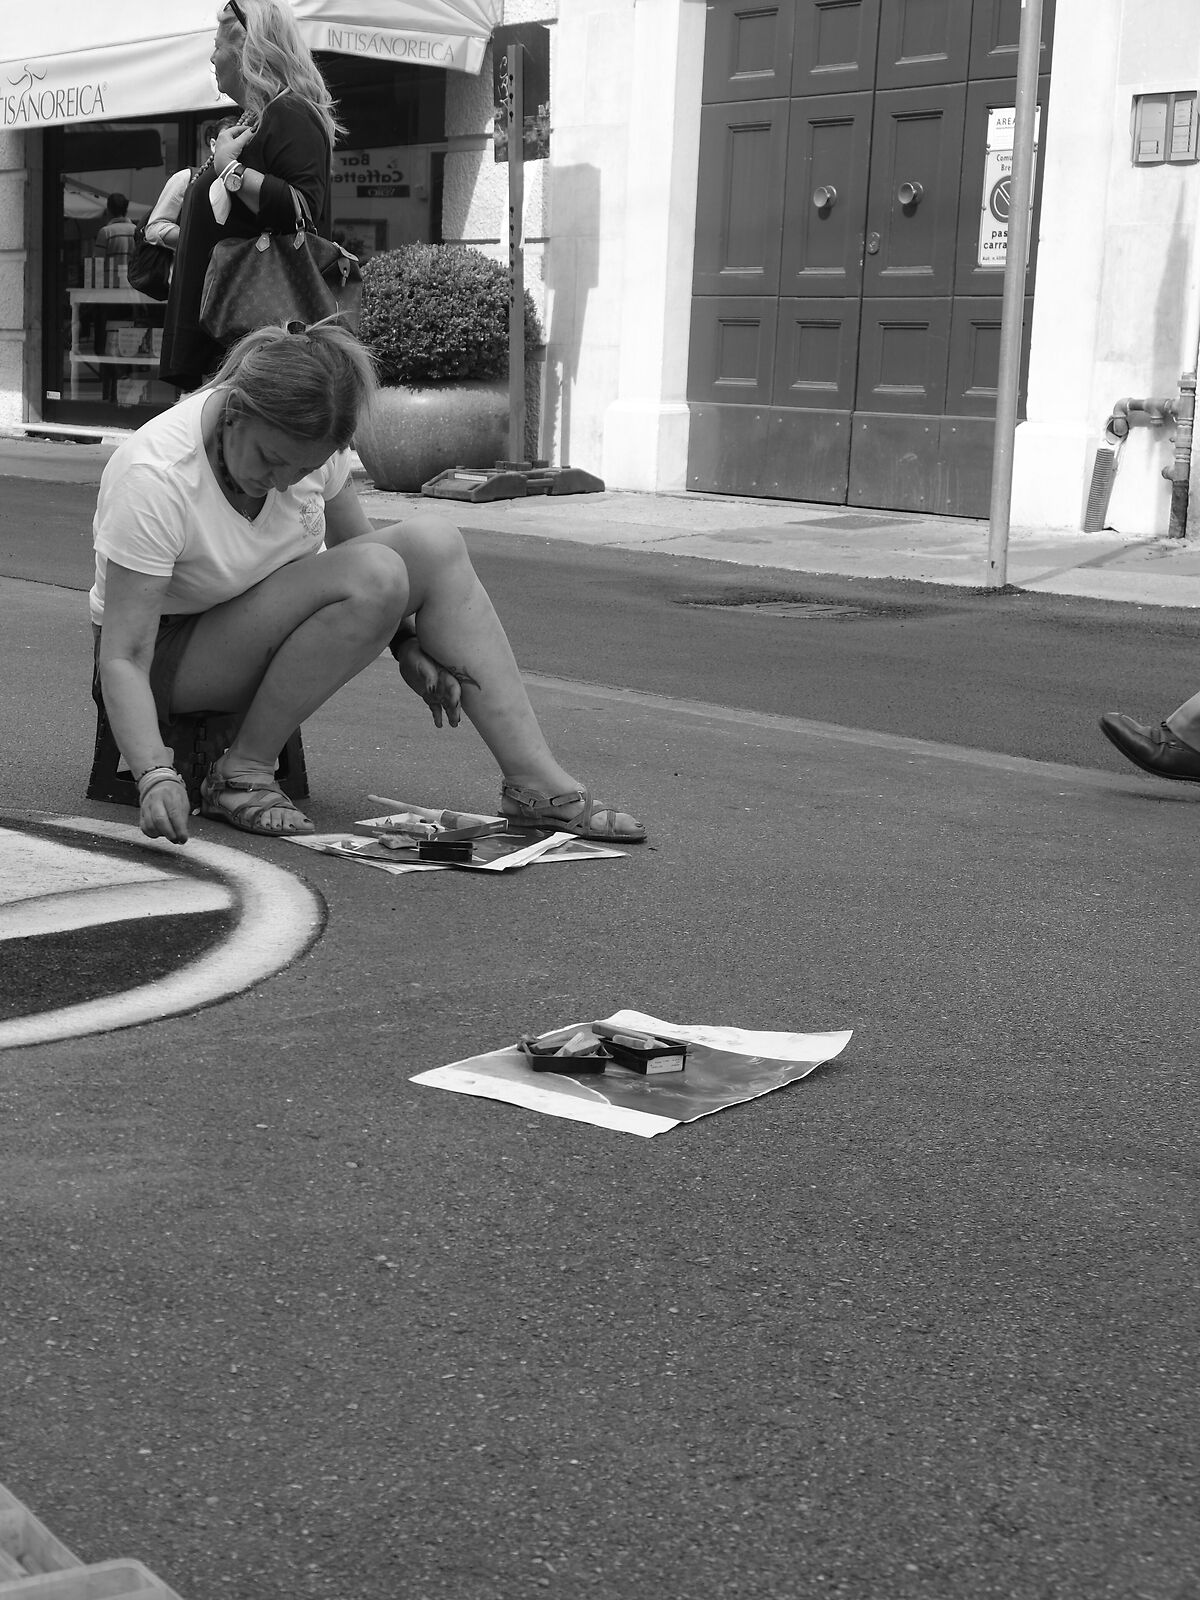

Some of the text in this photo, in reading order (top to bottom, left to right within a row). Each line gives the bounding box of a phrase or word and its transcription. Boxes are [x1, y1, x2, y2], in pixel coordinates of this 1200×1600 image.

[327, 28, 455, 63] INTISANOREICA
[996, 153, 1013, 162] Comu
[991, 230, 1008, 240] pas
